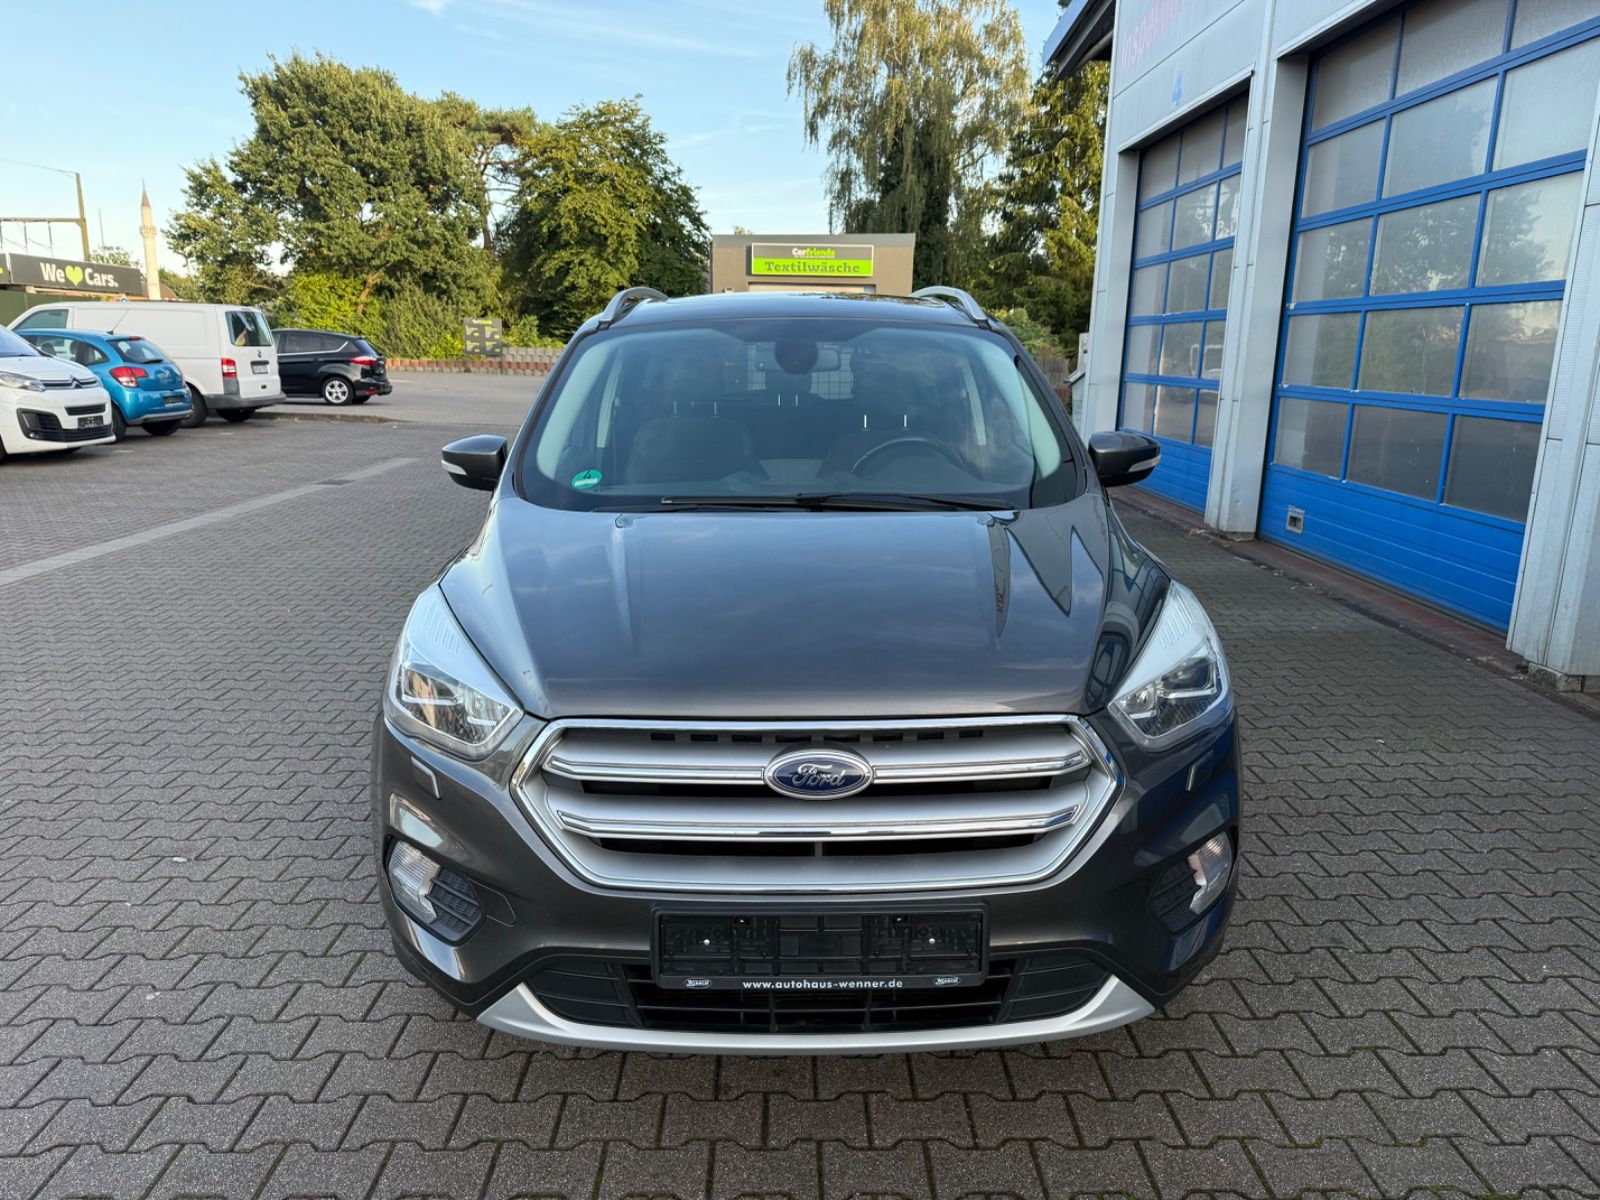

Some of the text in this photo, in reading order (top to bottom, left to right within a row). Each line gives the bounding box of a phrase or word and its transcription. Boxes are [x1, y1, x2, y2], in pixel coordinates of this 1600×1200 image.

[1171, 70, 1183, 107] 4
[40, 262, 119, 288] We Cars.
[764, 261, 860, 274] Textilwäsche
[791, 763, 847, 787] Ford
[742, 979, 903, 989] www.autohaus-wenner.de
